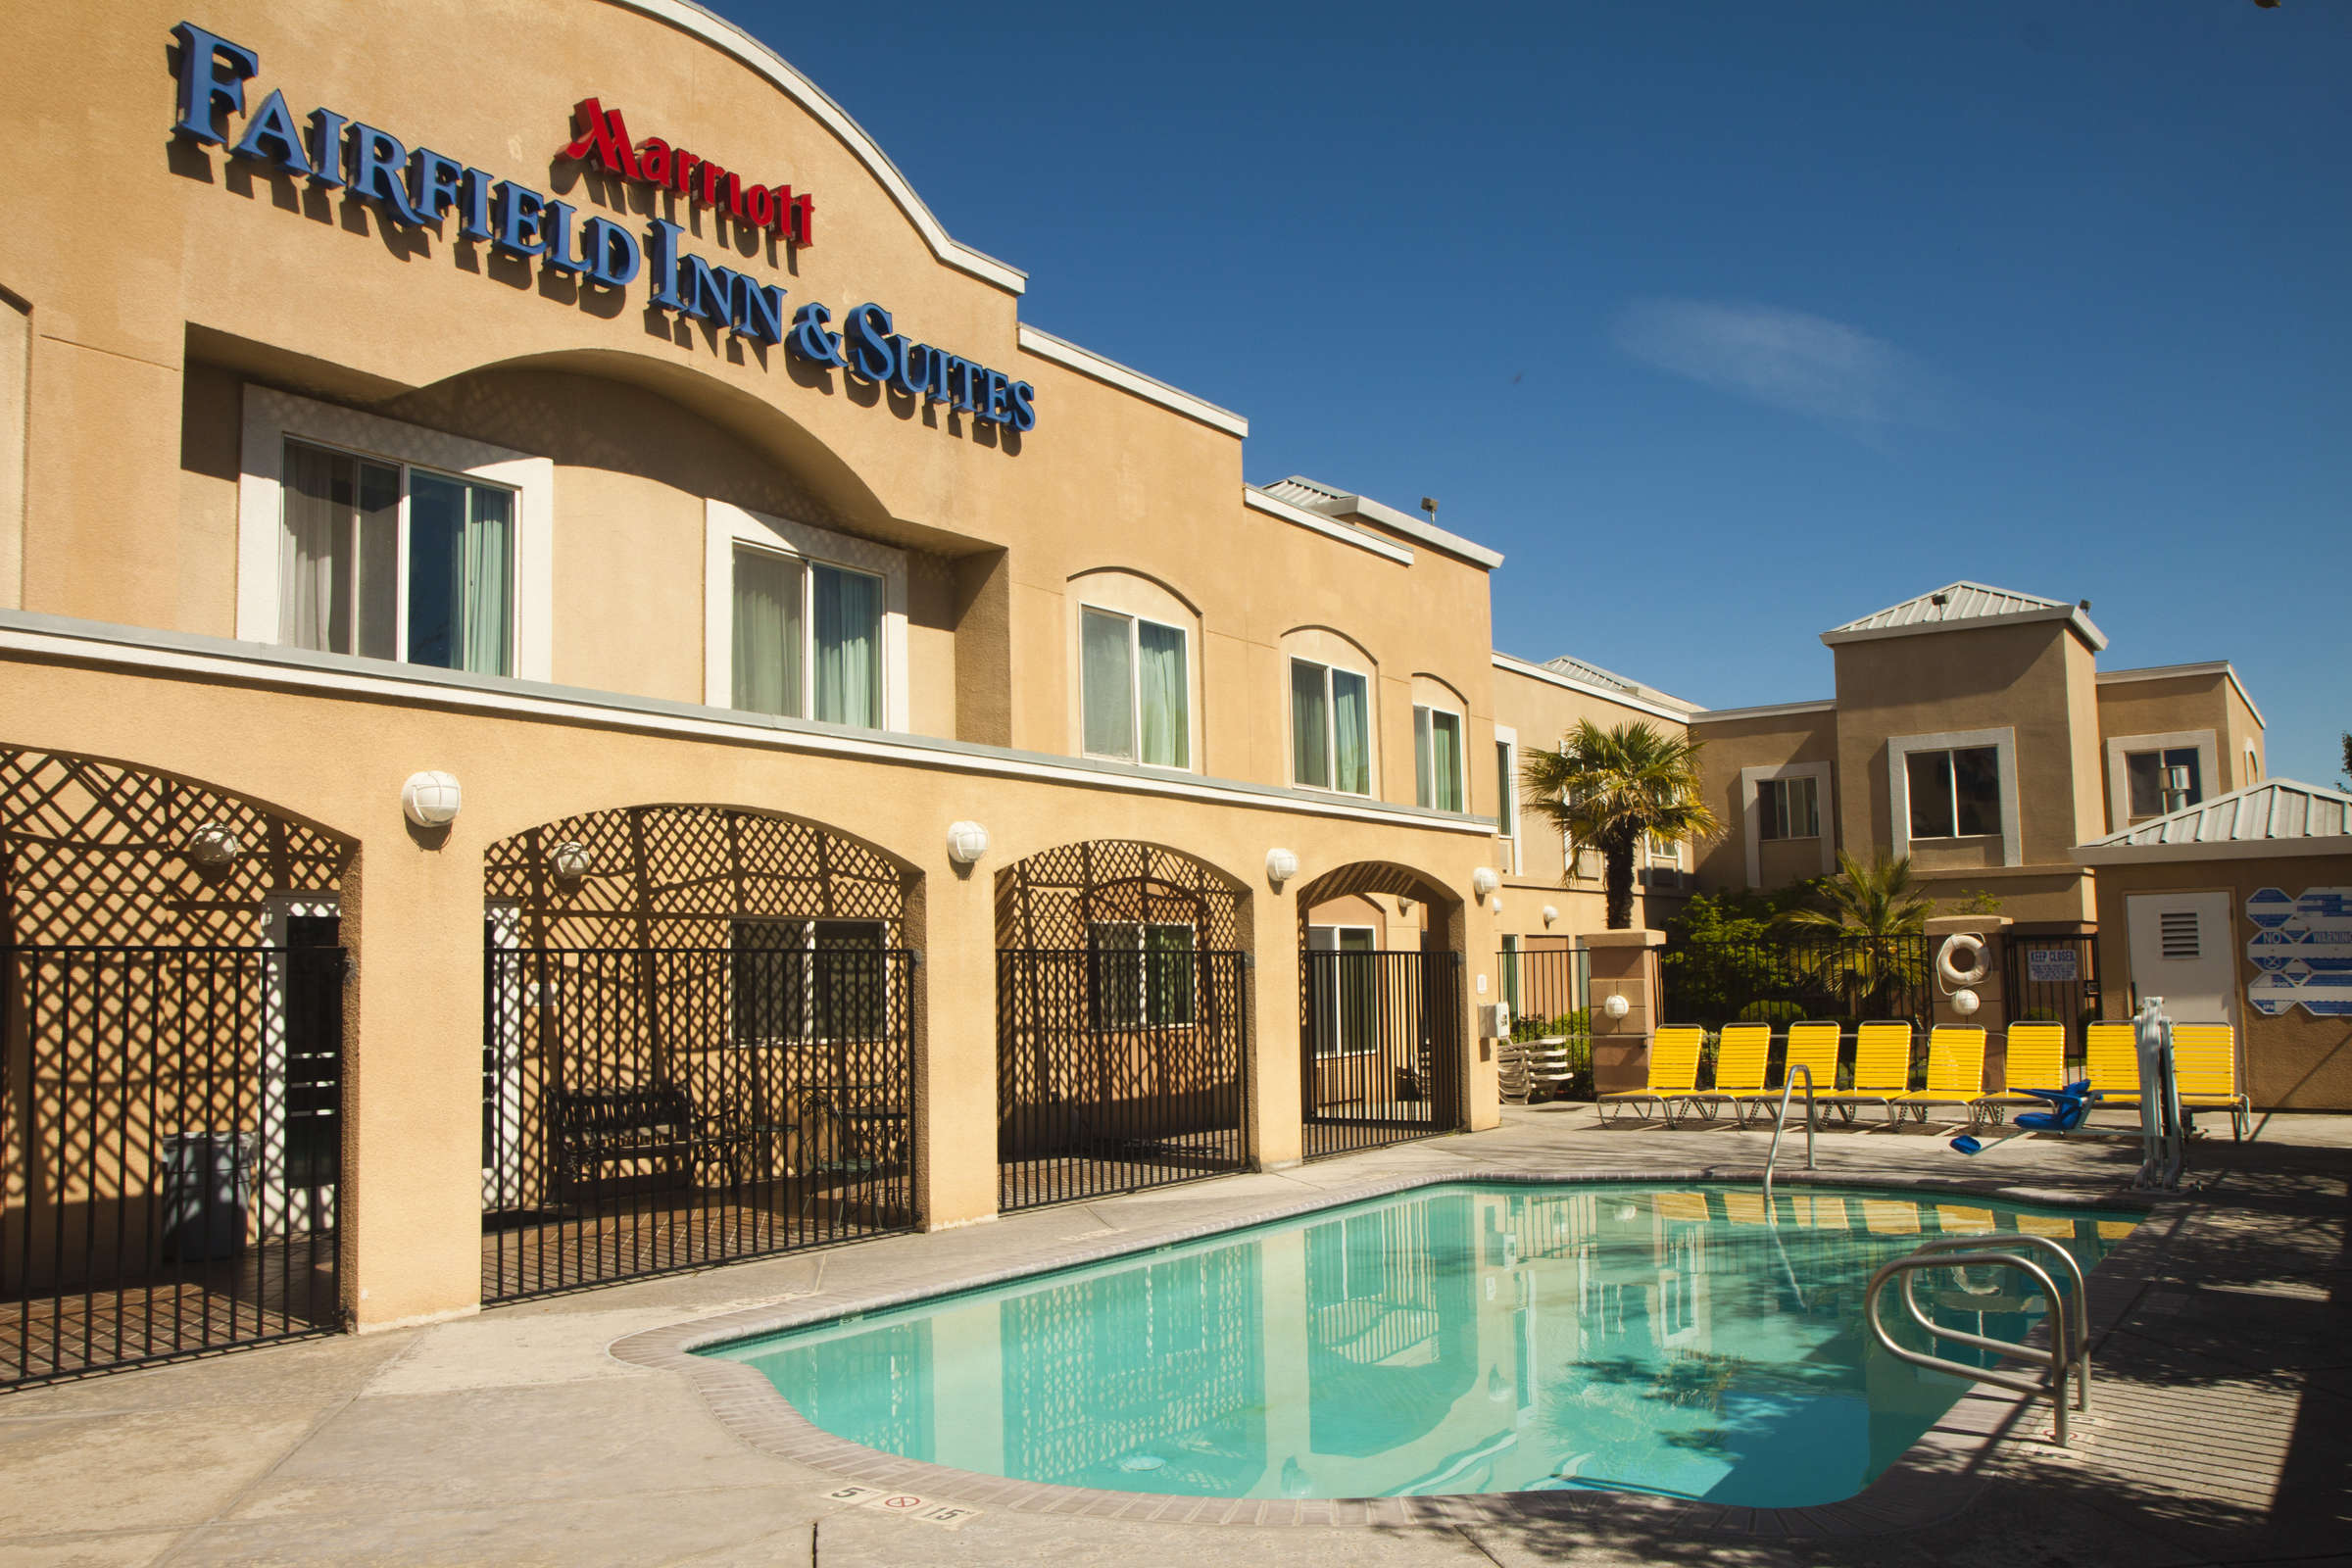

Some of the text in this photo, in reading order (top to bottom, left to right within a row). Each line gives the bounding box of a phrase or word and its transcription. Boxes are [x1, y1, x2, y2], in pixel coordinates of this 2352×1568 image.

[554, 96, 815, 251] Marriott
[170, 21, 1036, 432] FAIRFIELD INN & SUITES
[2263, 931, 2282, 944] NO
[2031, 950, 2048, 962] KEEP
[831, 1487, 865, 1498] 5
